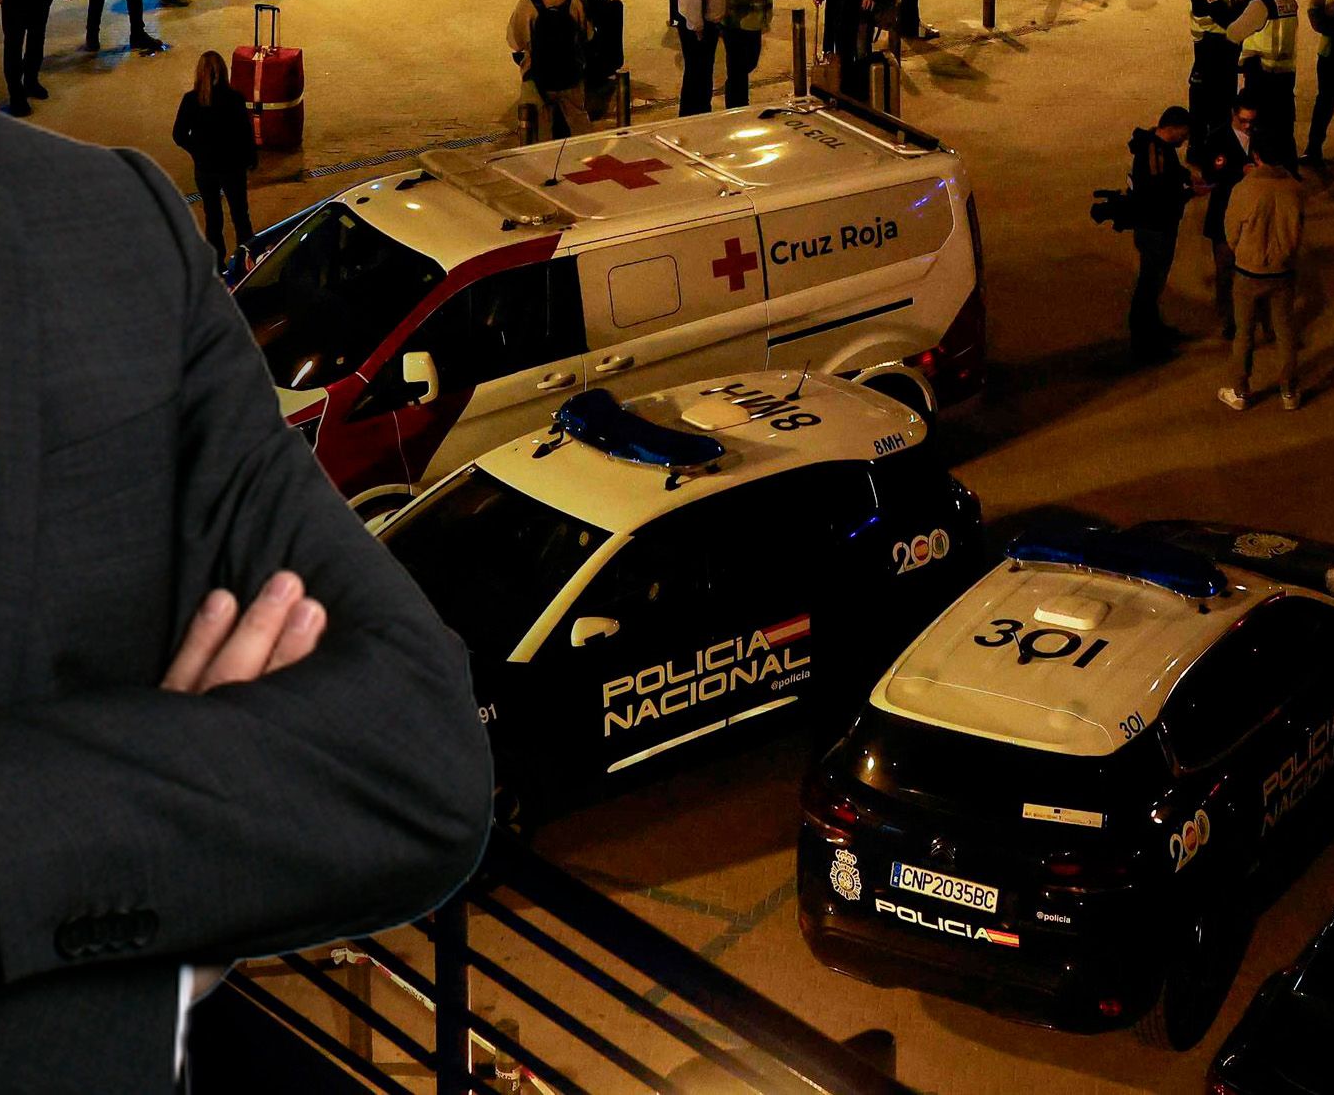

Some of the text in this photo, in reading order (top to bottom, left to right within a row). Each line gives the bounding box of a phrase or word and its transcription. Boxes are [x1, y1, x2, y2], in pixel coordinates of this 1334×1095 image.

[770, 216, 898, 265] Cruz Roja
[873, 433, 906, 455] 8MH
[973, 618, 1110, 668] 301
[604, 648, 811, 737] NACIONAL
[1119, 711, 1146, 740] 301
[900, 867, 996, 910] CNP2035BC
